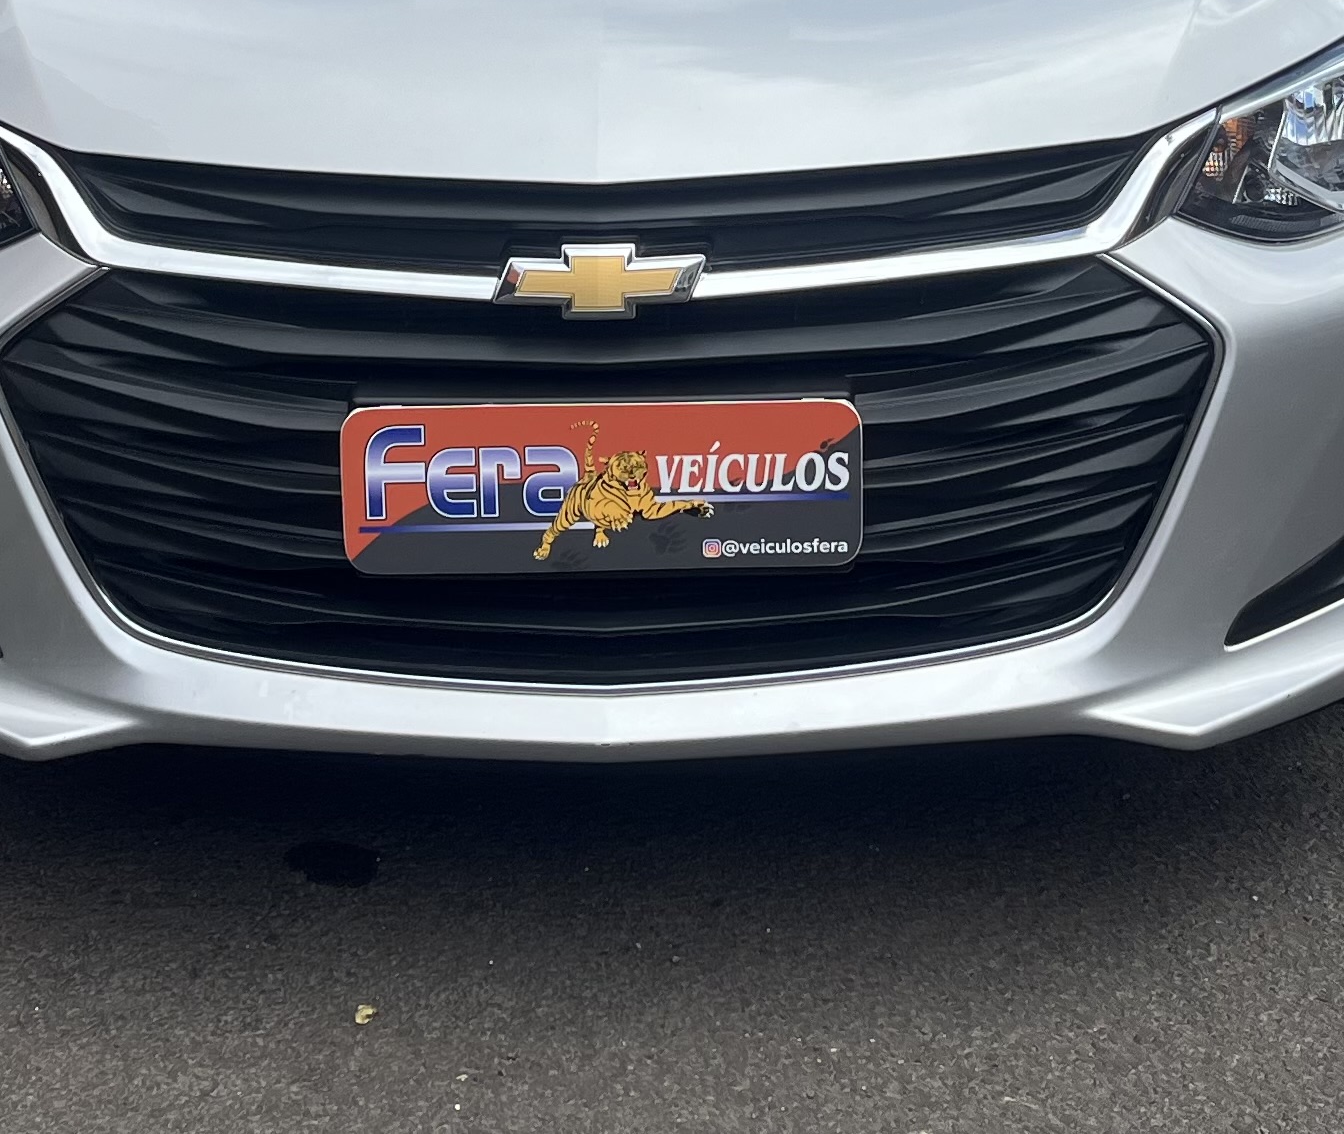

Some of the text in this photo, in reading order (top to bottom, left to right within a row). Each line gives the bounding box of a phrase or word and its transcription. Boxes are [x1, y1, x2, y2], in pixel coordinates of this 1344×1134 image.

[365, 424, 851, 521] Fera VEÍCULOS
[721, 537, 849, 557] @veiculosfera
